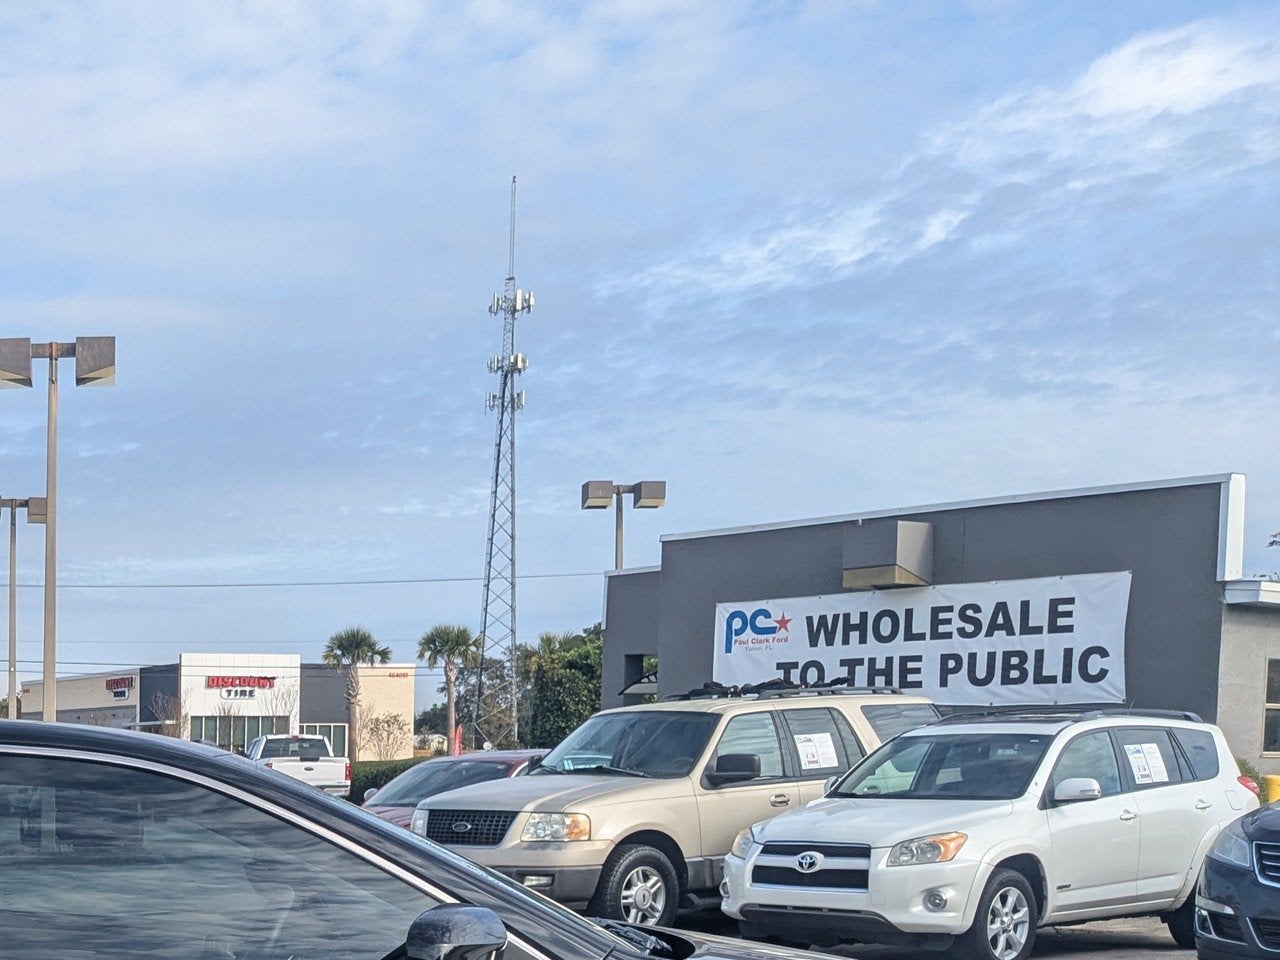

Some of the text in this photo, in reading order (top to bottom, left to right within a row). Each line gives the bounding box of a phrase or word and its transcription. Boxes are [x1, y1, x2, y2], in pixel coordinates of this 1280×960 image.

[806, 597, 1075, 647] WHOLESALE
[776, 645, 1110, 689] TO THE PUBLIC
[206, 676, 276, 688] DISCOUNT
[225, 689, 255, 697] TIRE
